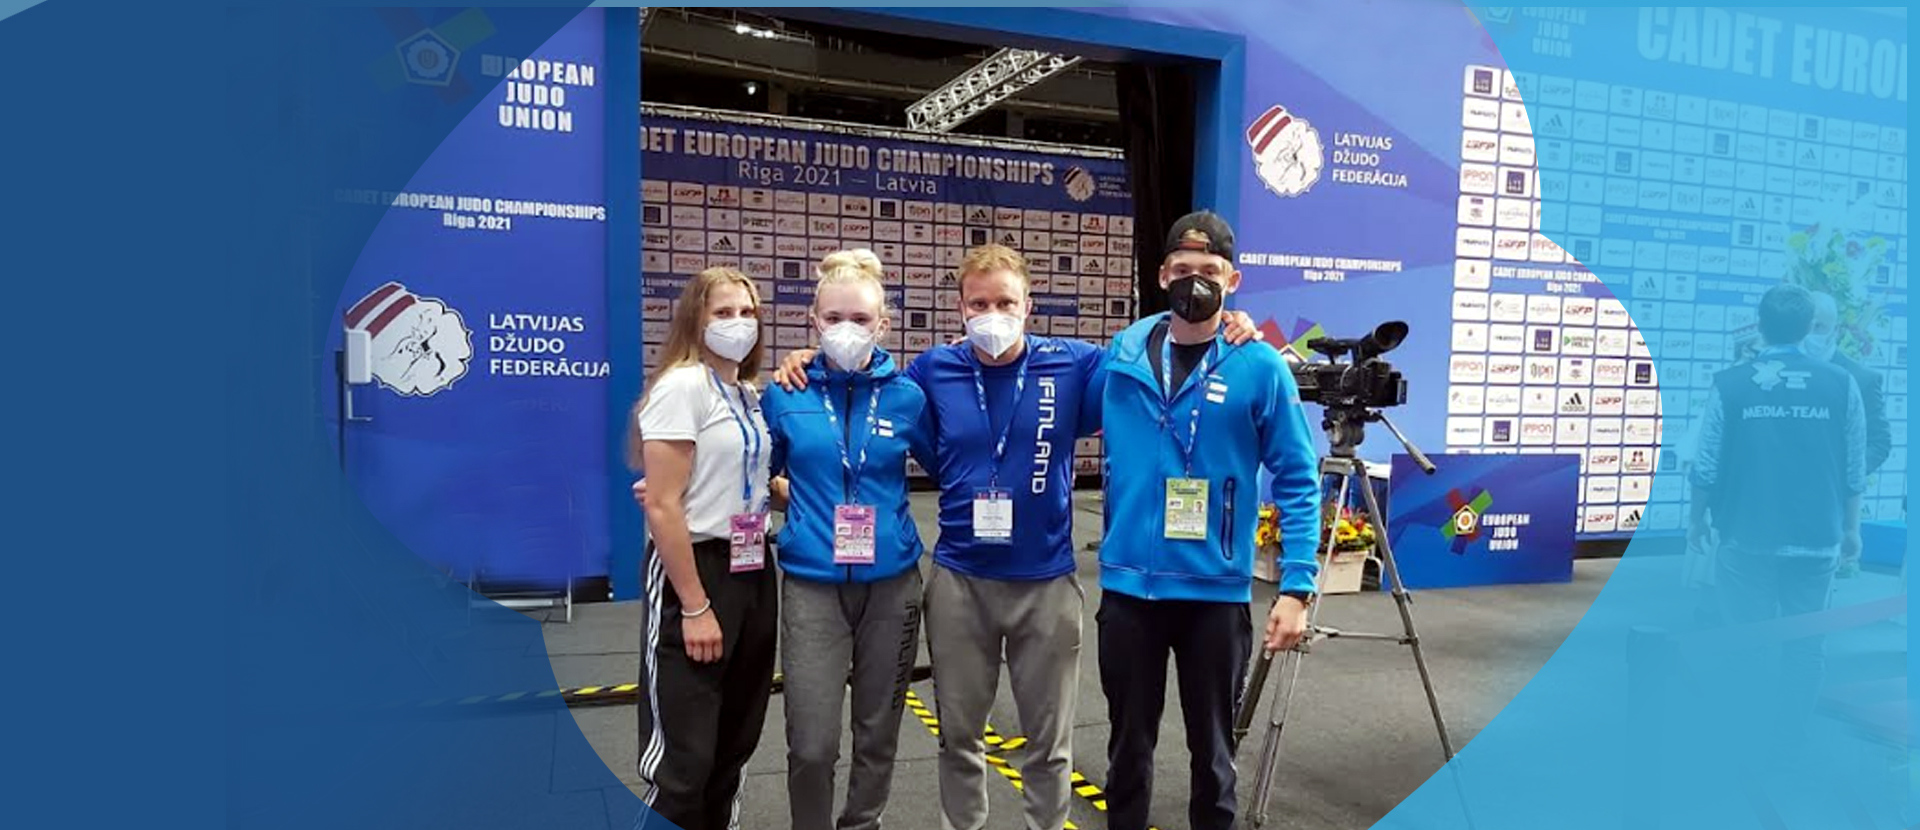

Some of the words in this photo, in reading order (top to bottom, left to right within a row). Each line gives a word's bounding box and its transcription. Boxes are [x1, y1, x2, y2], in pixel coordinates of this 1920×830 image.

[480, 53, 595, 87] EUROPEAN
[505, 81, 565, 107] JUDO
[498, 104, 573, 133] UNION
[1334, 133, 1392, 150] LATVIJAS
[684, 129, 806, 164] EUROPEAN
[813, 142, 870, 171] JUDO
[877, 147, 1054, 186] CHAMPIONSHIPS
[1333, 150, 1379, 167] DŽUDO
[738, 161, 784, 185] Riga
[793, 165, 840, 186] 2021
[876, 173, 937, 195] Latvia
[1332, 169, 1408, 187] FEDERĀCIJA
[382, 190, 454, 211] EUROPEAN
[456, 195, 491, 213] JUDO
[495, 199, 606, 221] CHAMPIONSHIPS
[442, 212, 476, 230] Riga
[478, 214, 512, 231] 2021
[489, 313, 585, 332] LATVIJAS
[489, 334, 565, 354] DŽUDO
[489, 358, 610, 377] FEDERĀCIJA
[1743, 405, 1830, 420] MEDIA-TEAM
